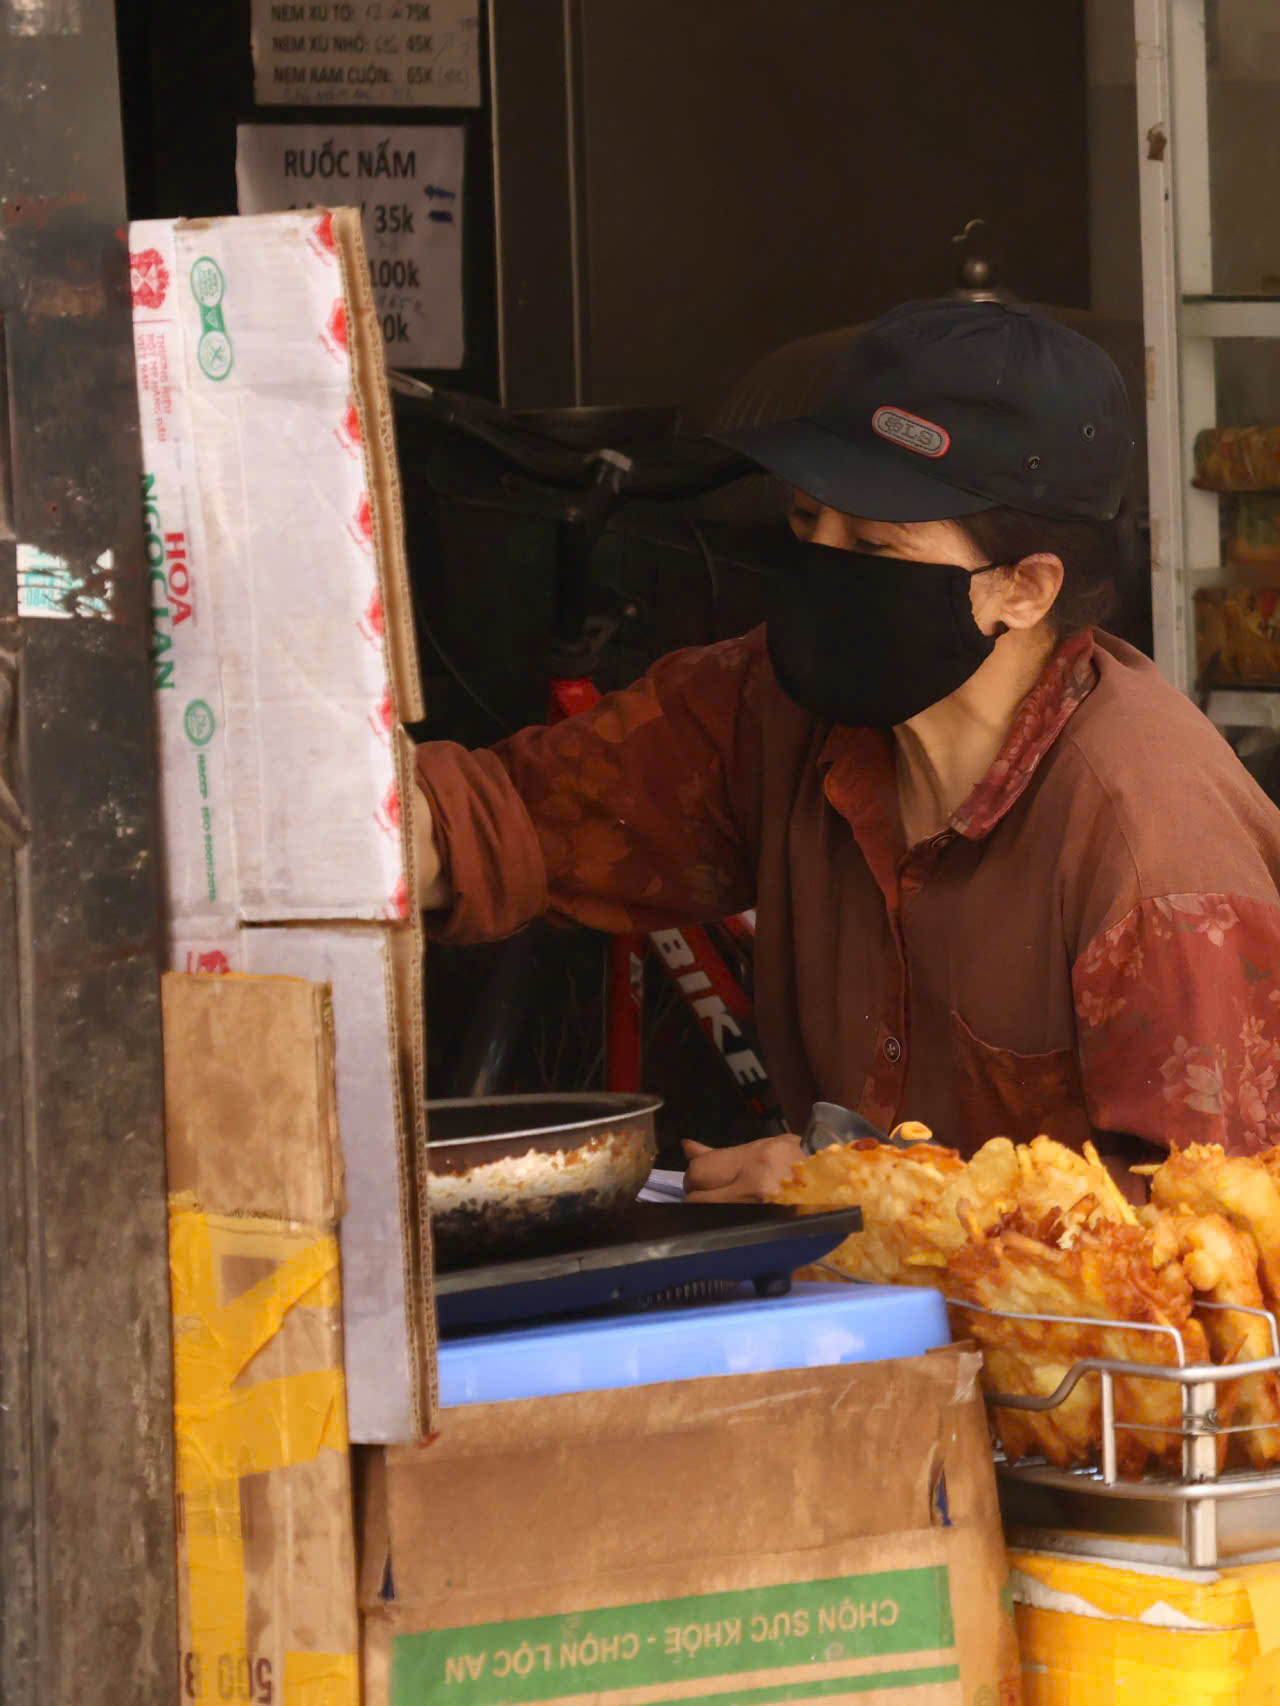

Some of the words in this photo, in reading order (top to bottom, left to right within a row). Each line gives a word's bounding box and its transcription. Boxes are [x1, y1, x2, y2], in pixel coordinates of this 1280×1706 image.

[283, 138, 349, 178] RUỐC
[357, 138, 416, 179] NẤM
[375, 202, 414, 234] 35k
[650, 927, 769, 1086] BIKE
[818, 1598, 899, 1635] CHỌN
[444, 1652, 489, 1685] AN
[492, 1641, 551, 1681] LỘC
[559, 1631, 640, 1671] CHỌN
